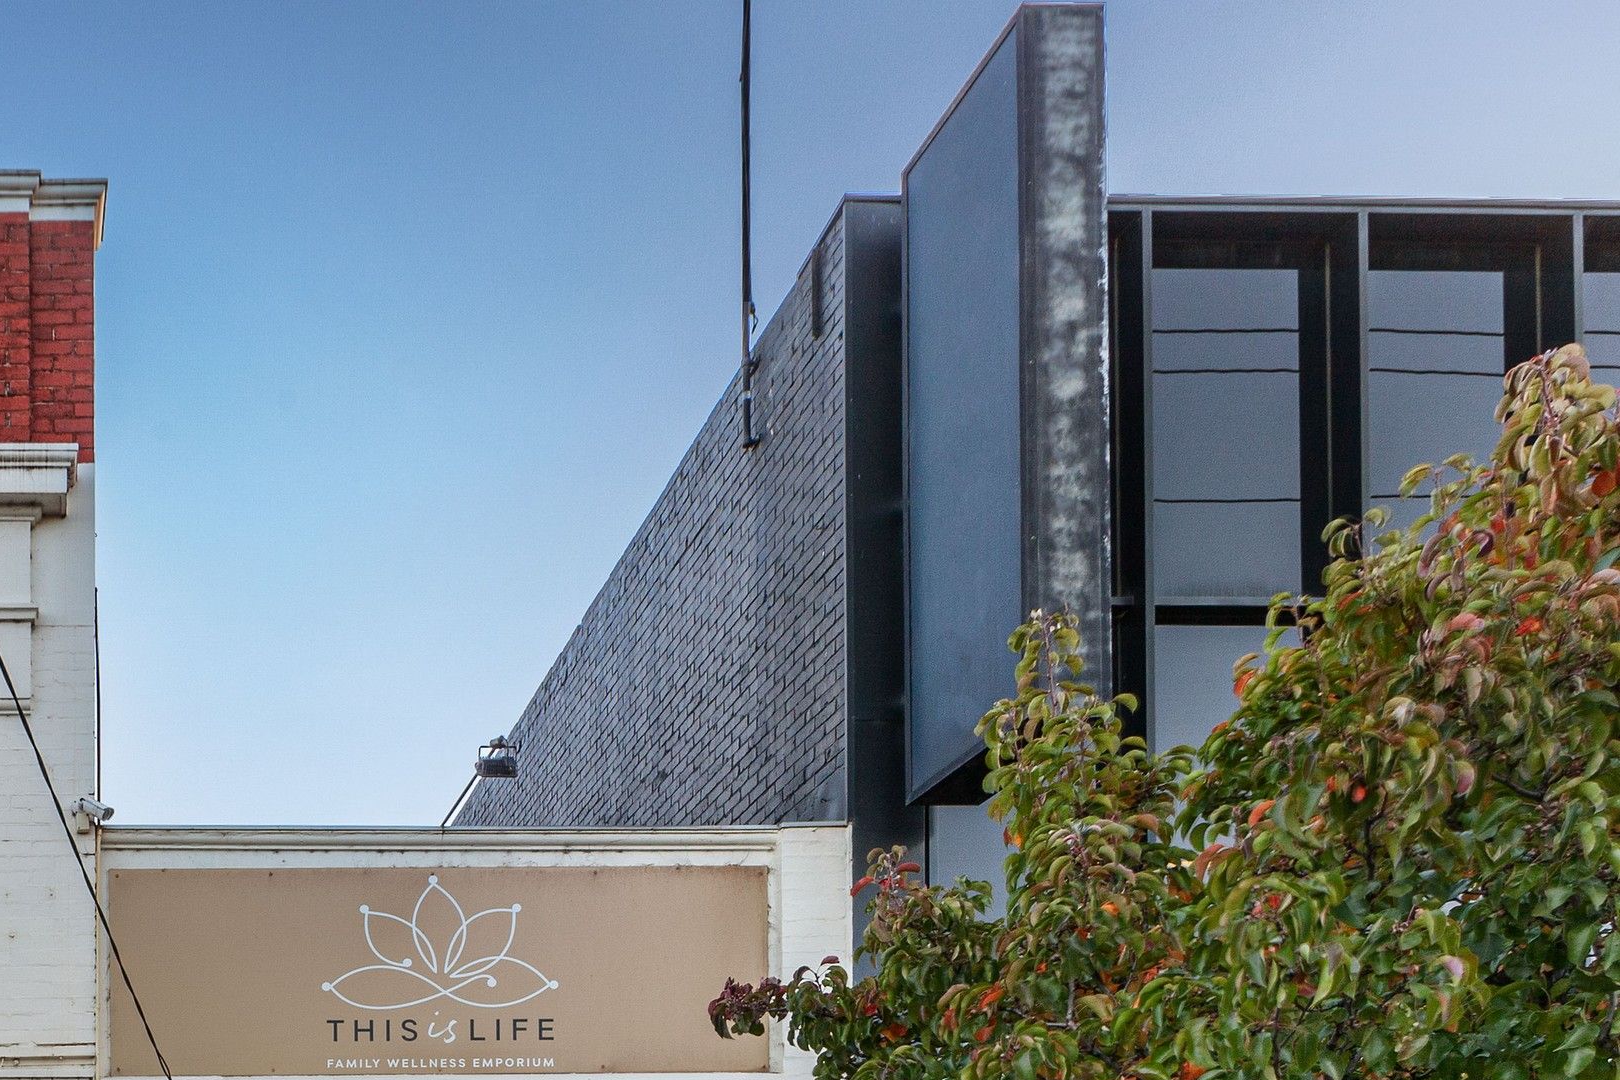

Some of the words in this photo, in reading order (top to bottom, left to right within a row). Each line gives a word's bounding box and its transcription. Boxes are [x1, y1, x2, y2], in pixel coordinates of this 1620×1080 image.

[326, 1019, 418, 1042] THIS
[428, 1010, 457, 1043] is
[470, 1018, 555, 1041] LIFE
[327, 1058, 380, 1069] FAMILY
[387, 1058, 466, 1068] WELLNESS
[473, 1057, 555, 1068] EMPORIUM
